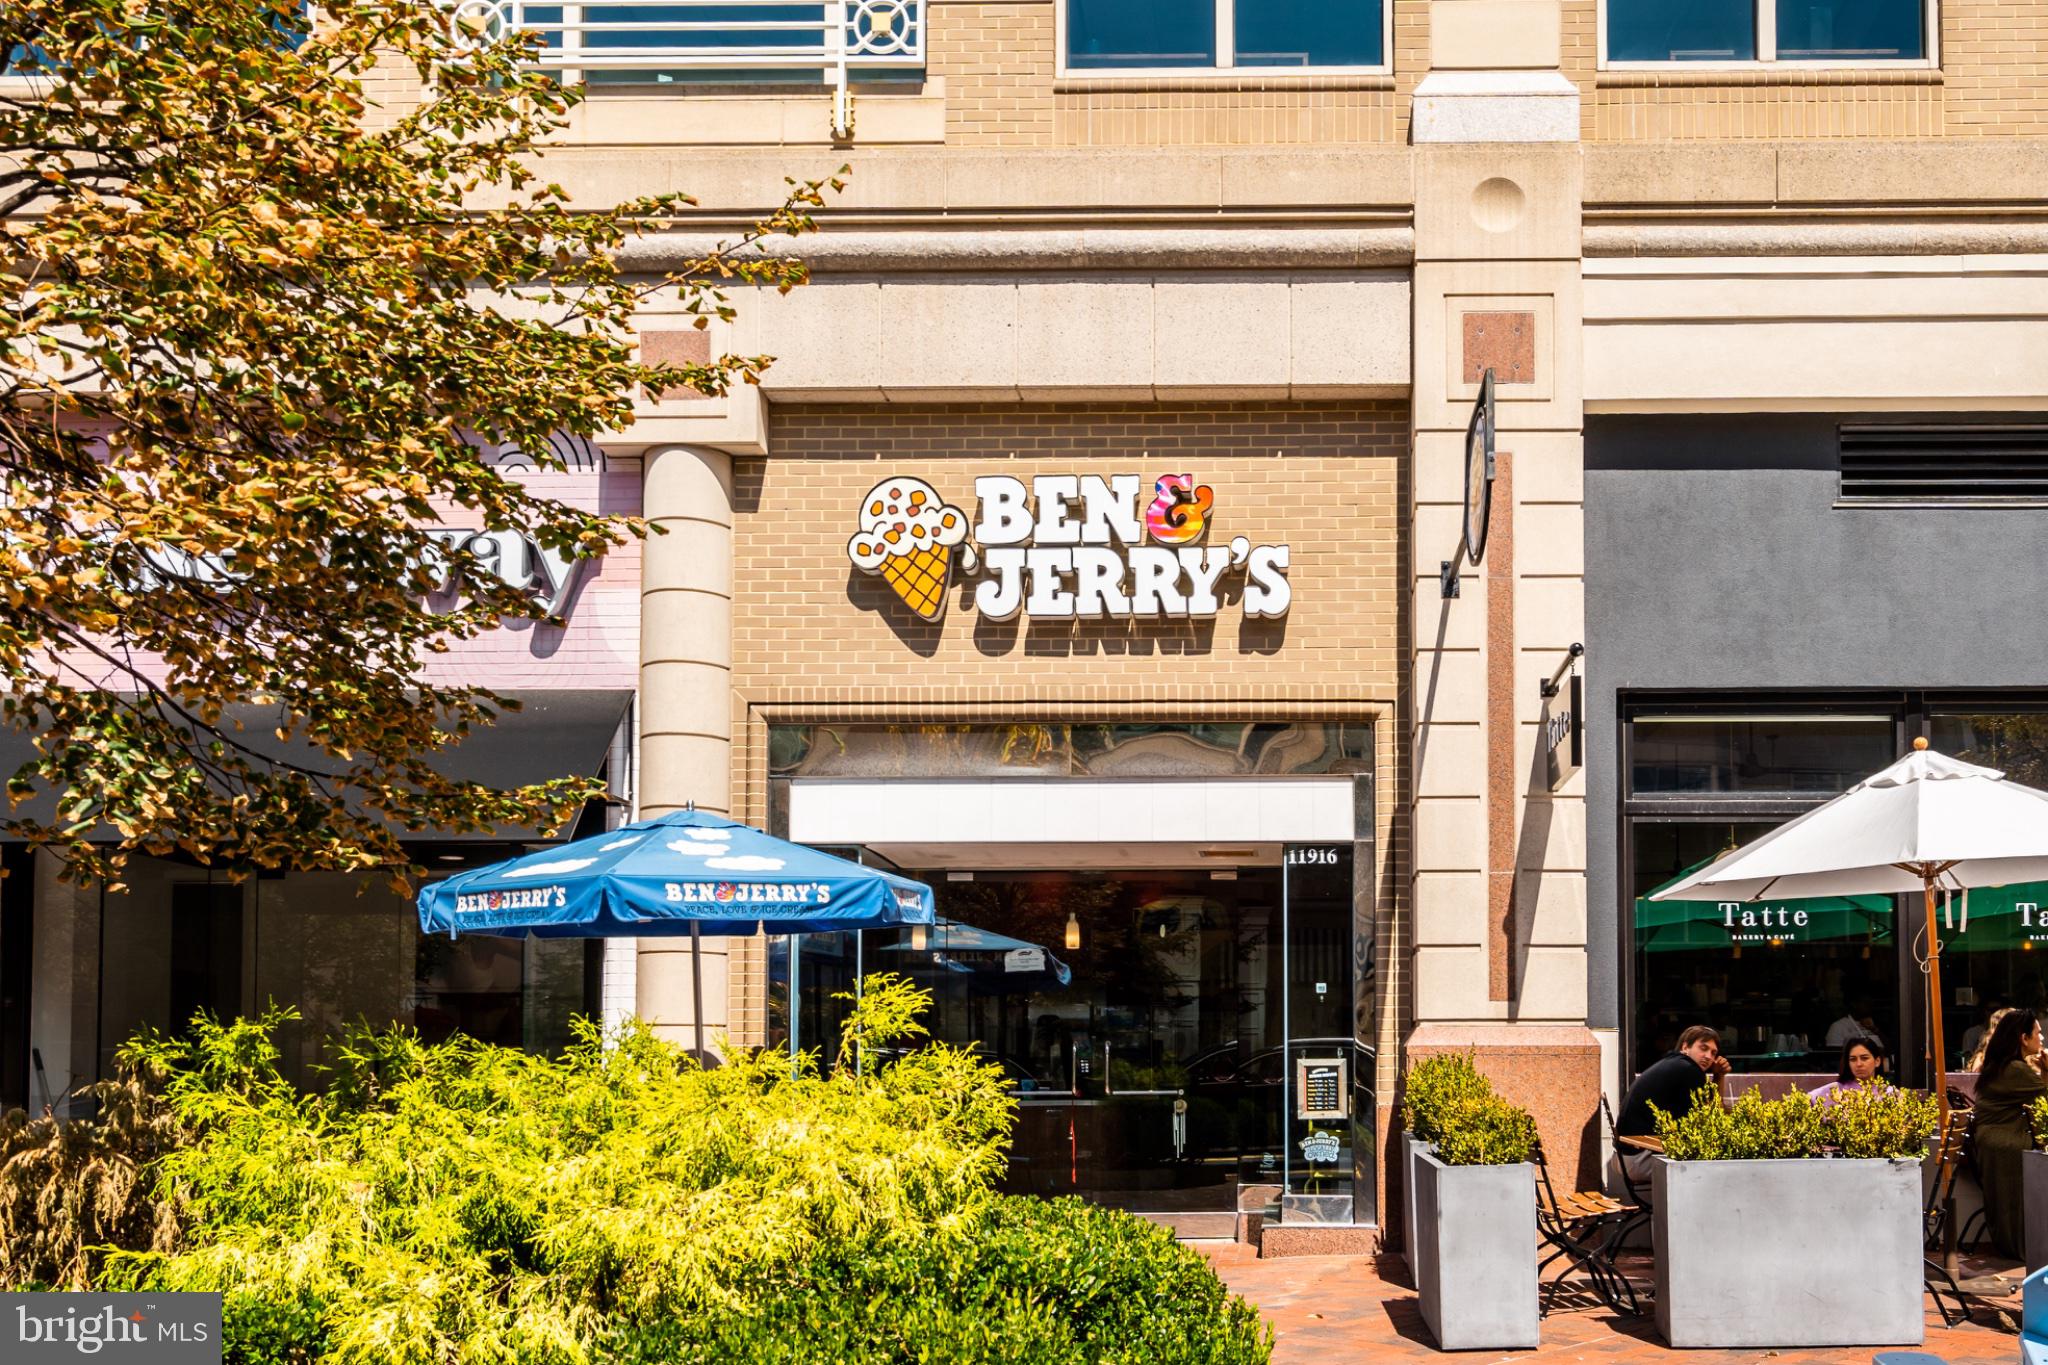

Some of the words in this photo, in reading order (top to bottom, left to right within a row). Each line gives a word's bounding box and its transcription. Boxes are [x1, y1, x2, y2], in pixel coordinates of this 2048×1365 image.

[975, 474, 1141, 543] BEN
[1146, 473, 1214, 544] &
[975, 536, 1292, 620] JERRY'S
[1288, 849, 1338, 864] 11916
[456, 894, 489, 912] BEN
[502, 885, 567, 910] JERRY'S
[665, 882, 715, 902] BEN
[736, 882, 831, 904] JERRY'S
[722, 905, 747, 914] LOVE
[1718, 903, 1808, 927] Tatte
